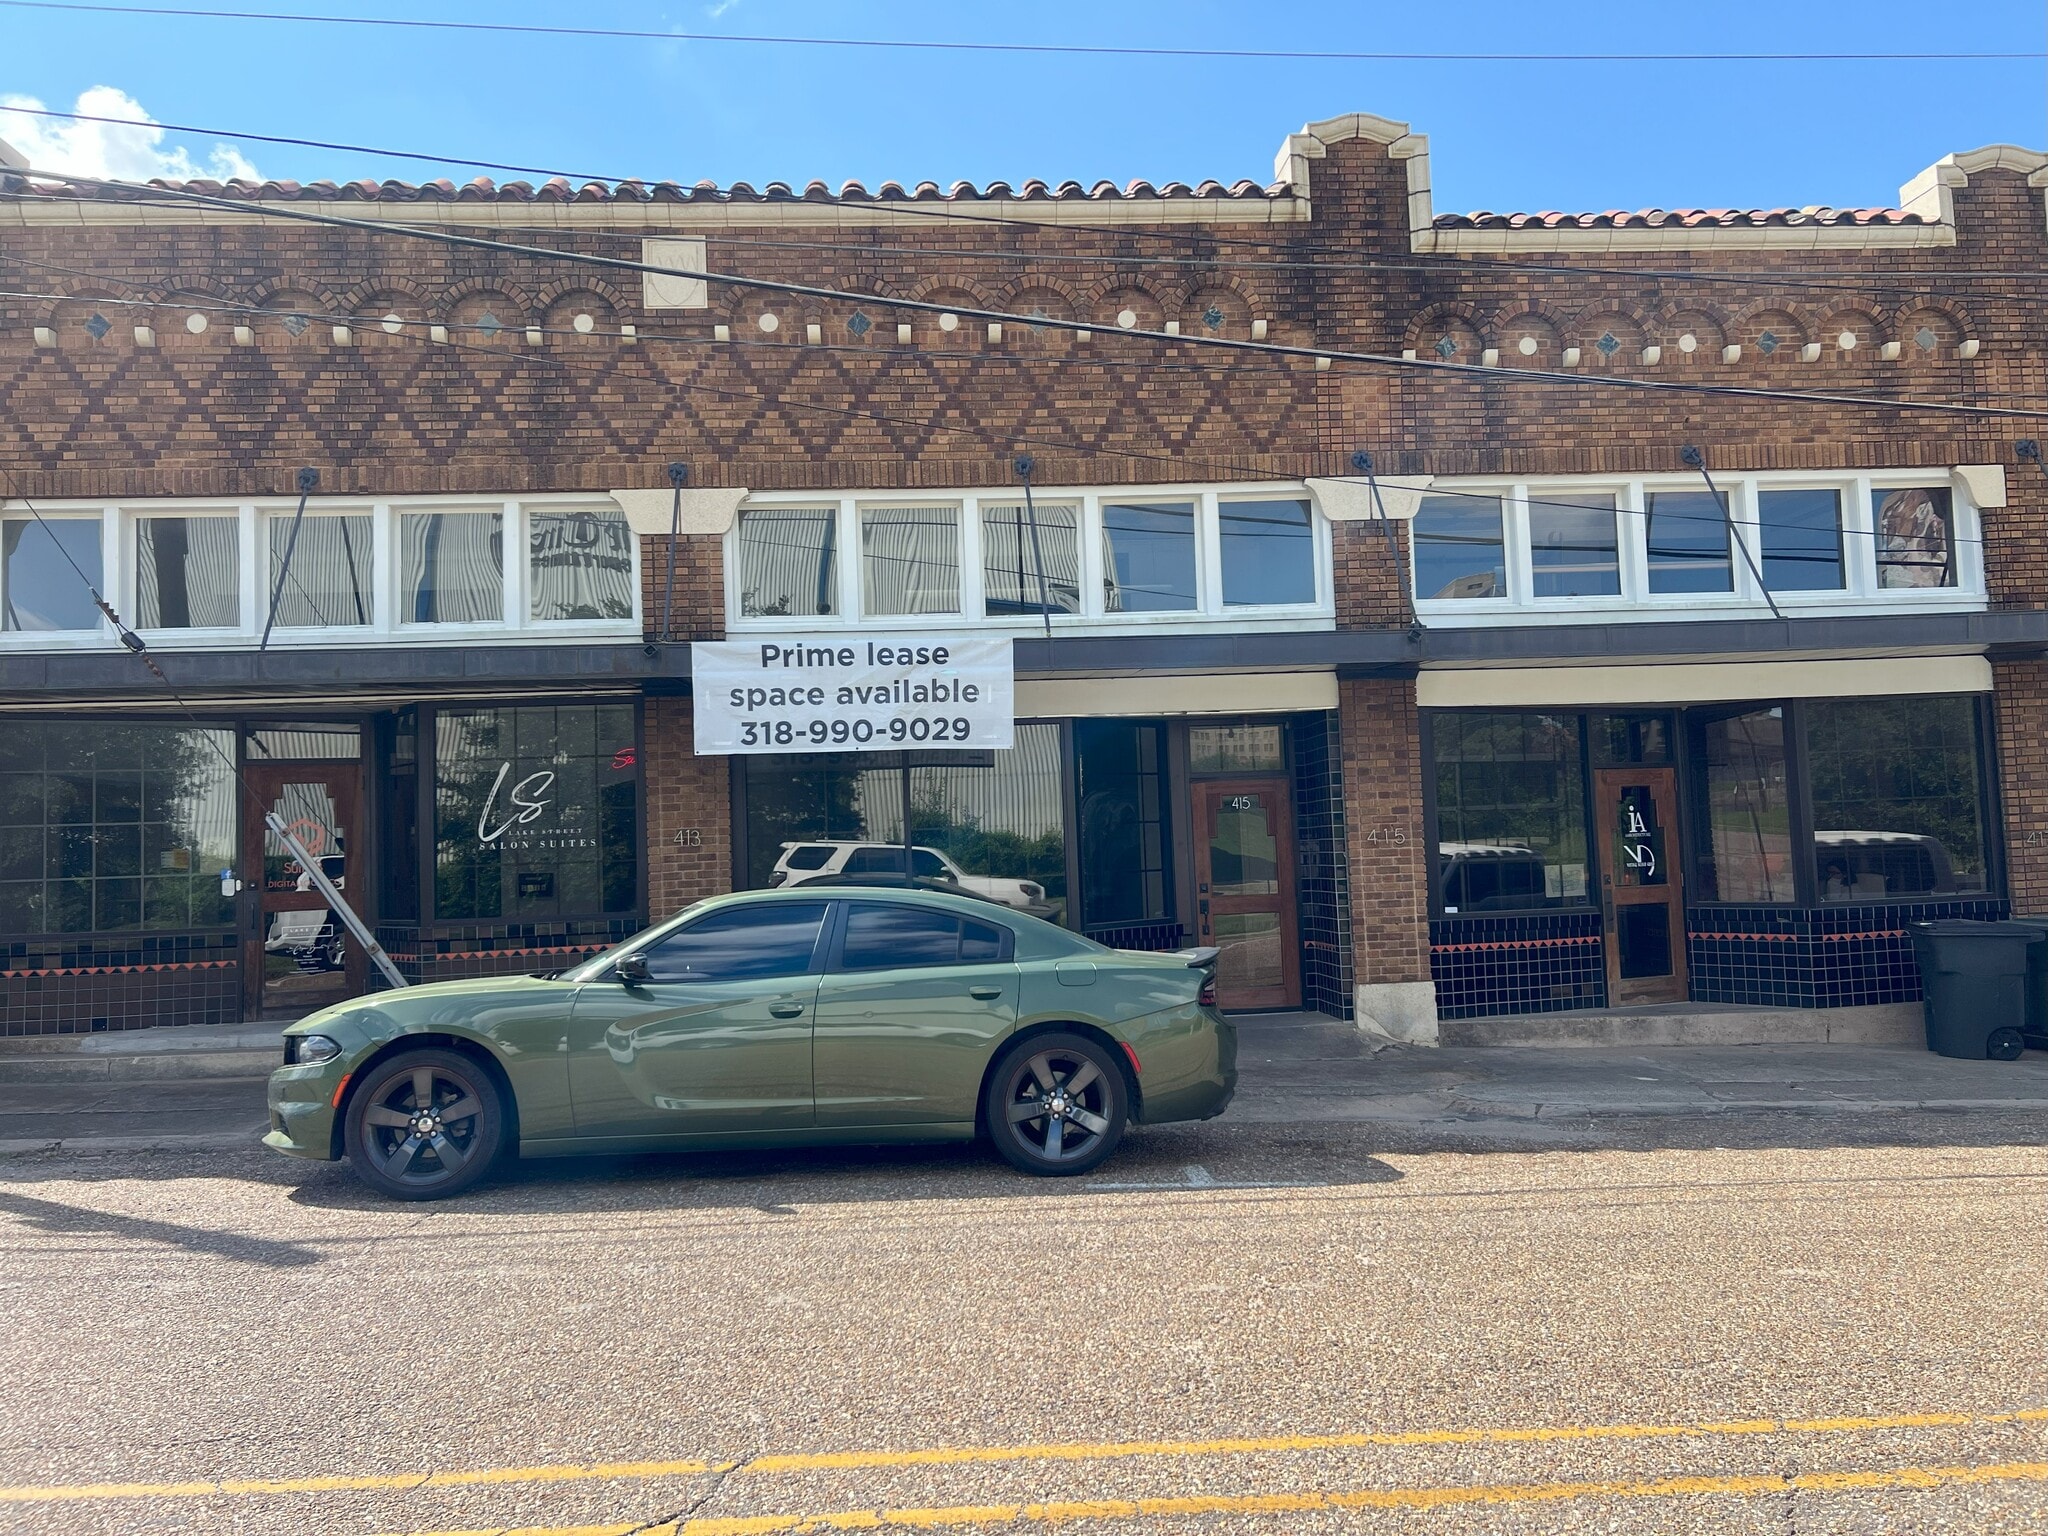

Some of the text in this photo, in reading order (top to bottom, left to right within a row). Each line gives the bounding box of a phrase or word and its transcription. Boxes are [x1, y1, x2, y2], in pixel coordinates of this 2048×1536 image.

[761, 642, 950, 668] Prime lease
[730, 678, 980, 711] space available
[741, 717, 971, 745] 318-990-9029
[1231, 796, 1251, 810] 415
[542, 827, 583, 835] STREET
[673, 828, 701, 847] 413
[1367, 828, 1406, 845] 415
[2026, 831, 2048, 847] 41
[479, 838, 597, 850] SALON SUITES
